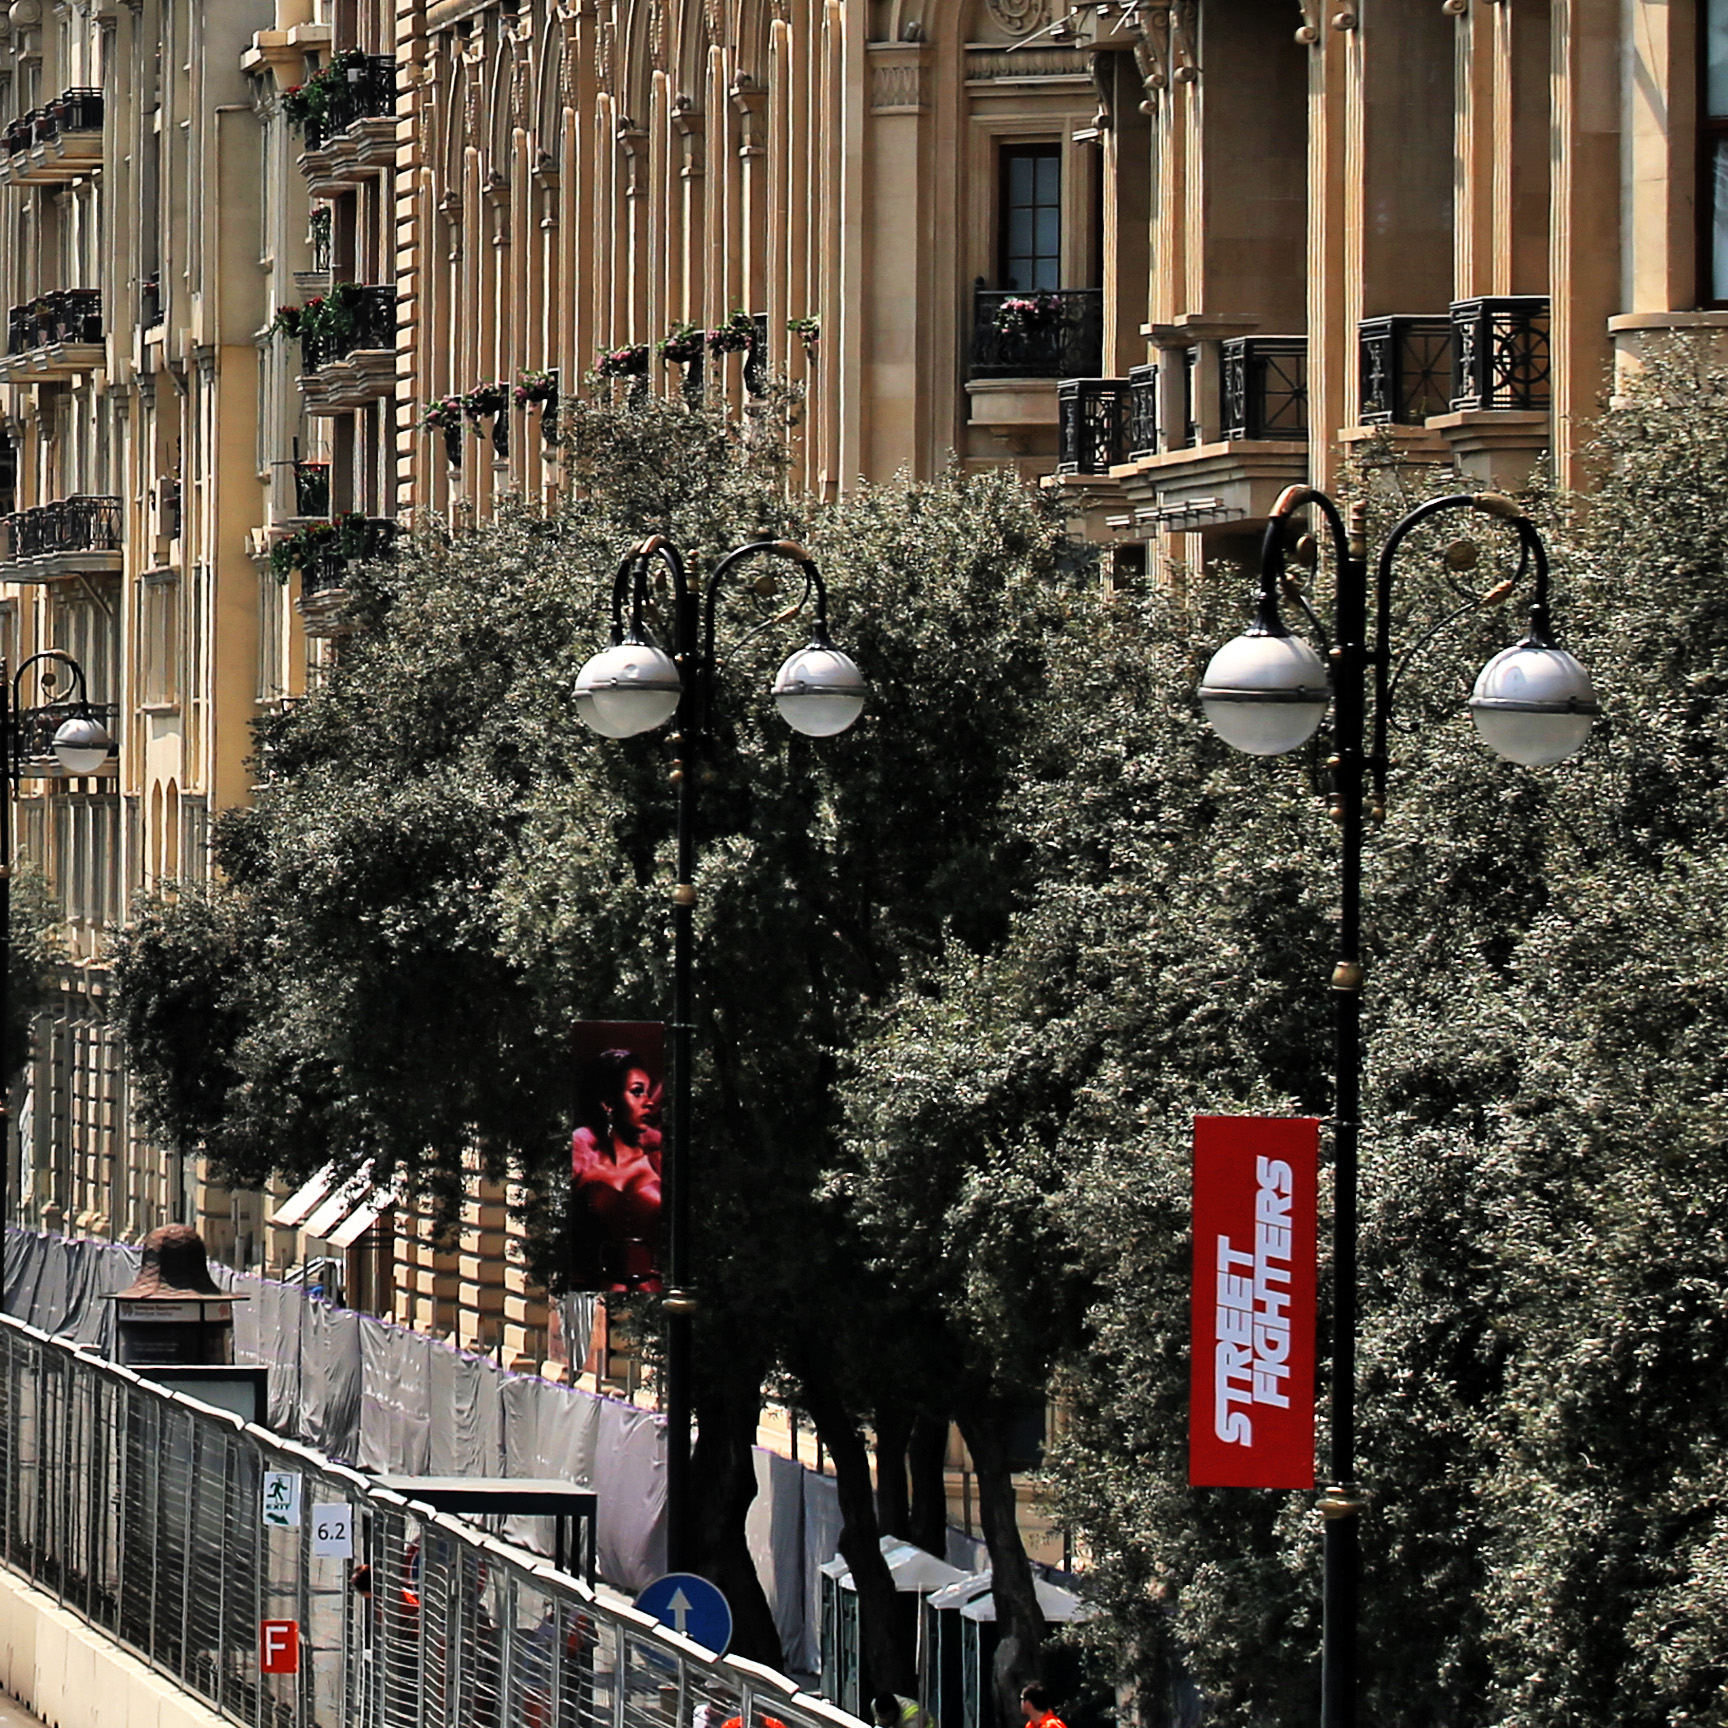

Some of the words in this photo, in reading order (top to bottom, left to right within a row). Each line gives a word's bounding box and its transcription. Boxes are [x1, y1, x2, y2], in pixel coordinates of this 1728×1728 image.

[1214, 1234, 1254, 1448] STREET
[1252, 1155, 1294, 1409] FIGHTERS
[317, 1522, 346, 1541] 6.2
[265, 1626, 289, 1667] F
